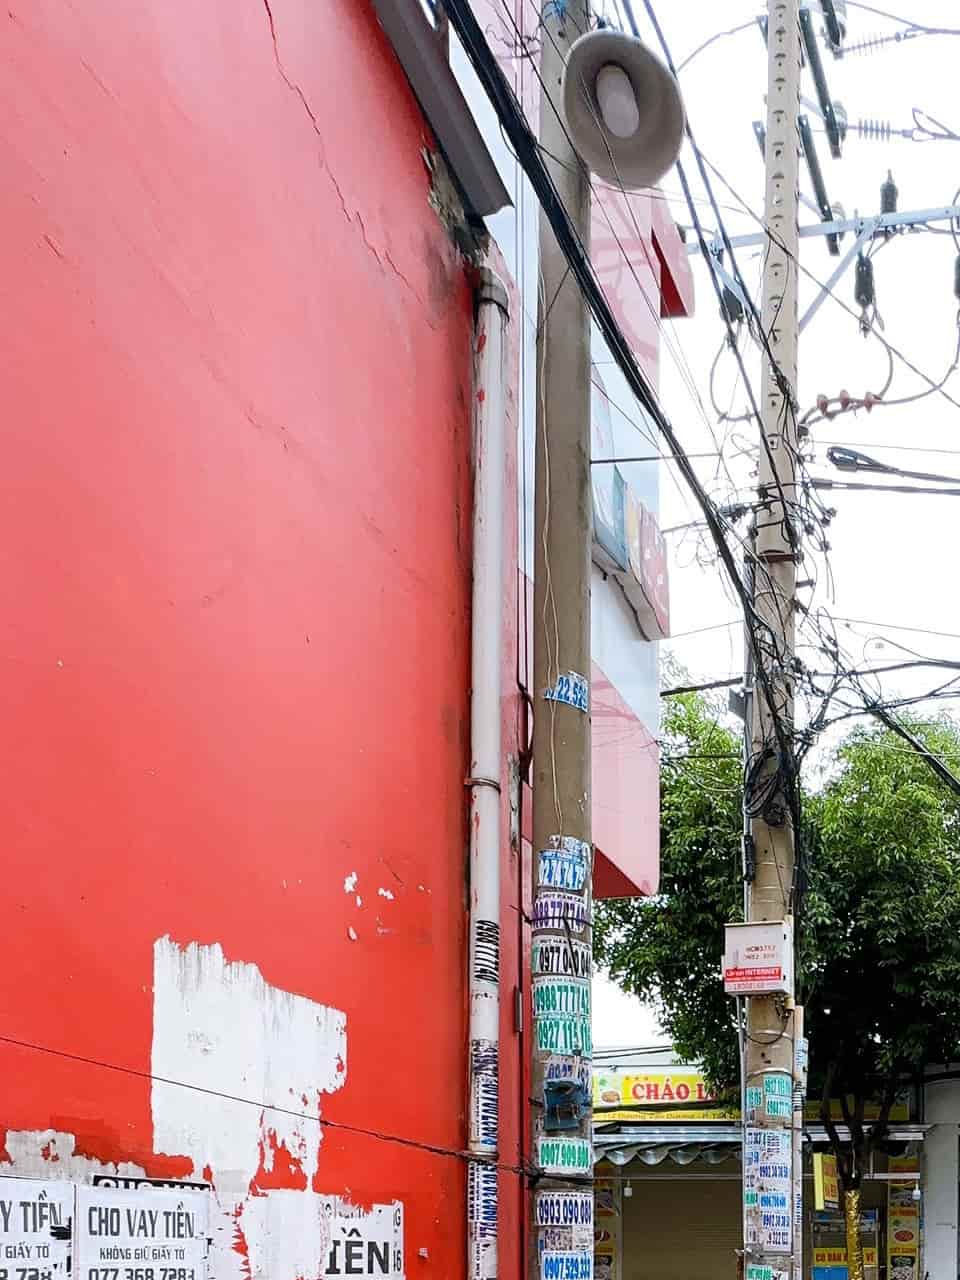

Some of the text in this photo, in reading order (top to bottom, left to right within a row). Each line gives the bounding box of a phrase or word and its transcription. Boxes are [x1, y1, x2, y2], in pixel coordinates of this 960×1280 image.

[632, 1079, 690, 1100] CHÁO
[89, 1201, 195, 1239] CHO VAY TIỀN
